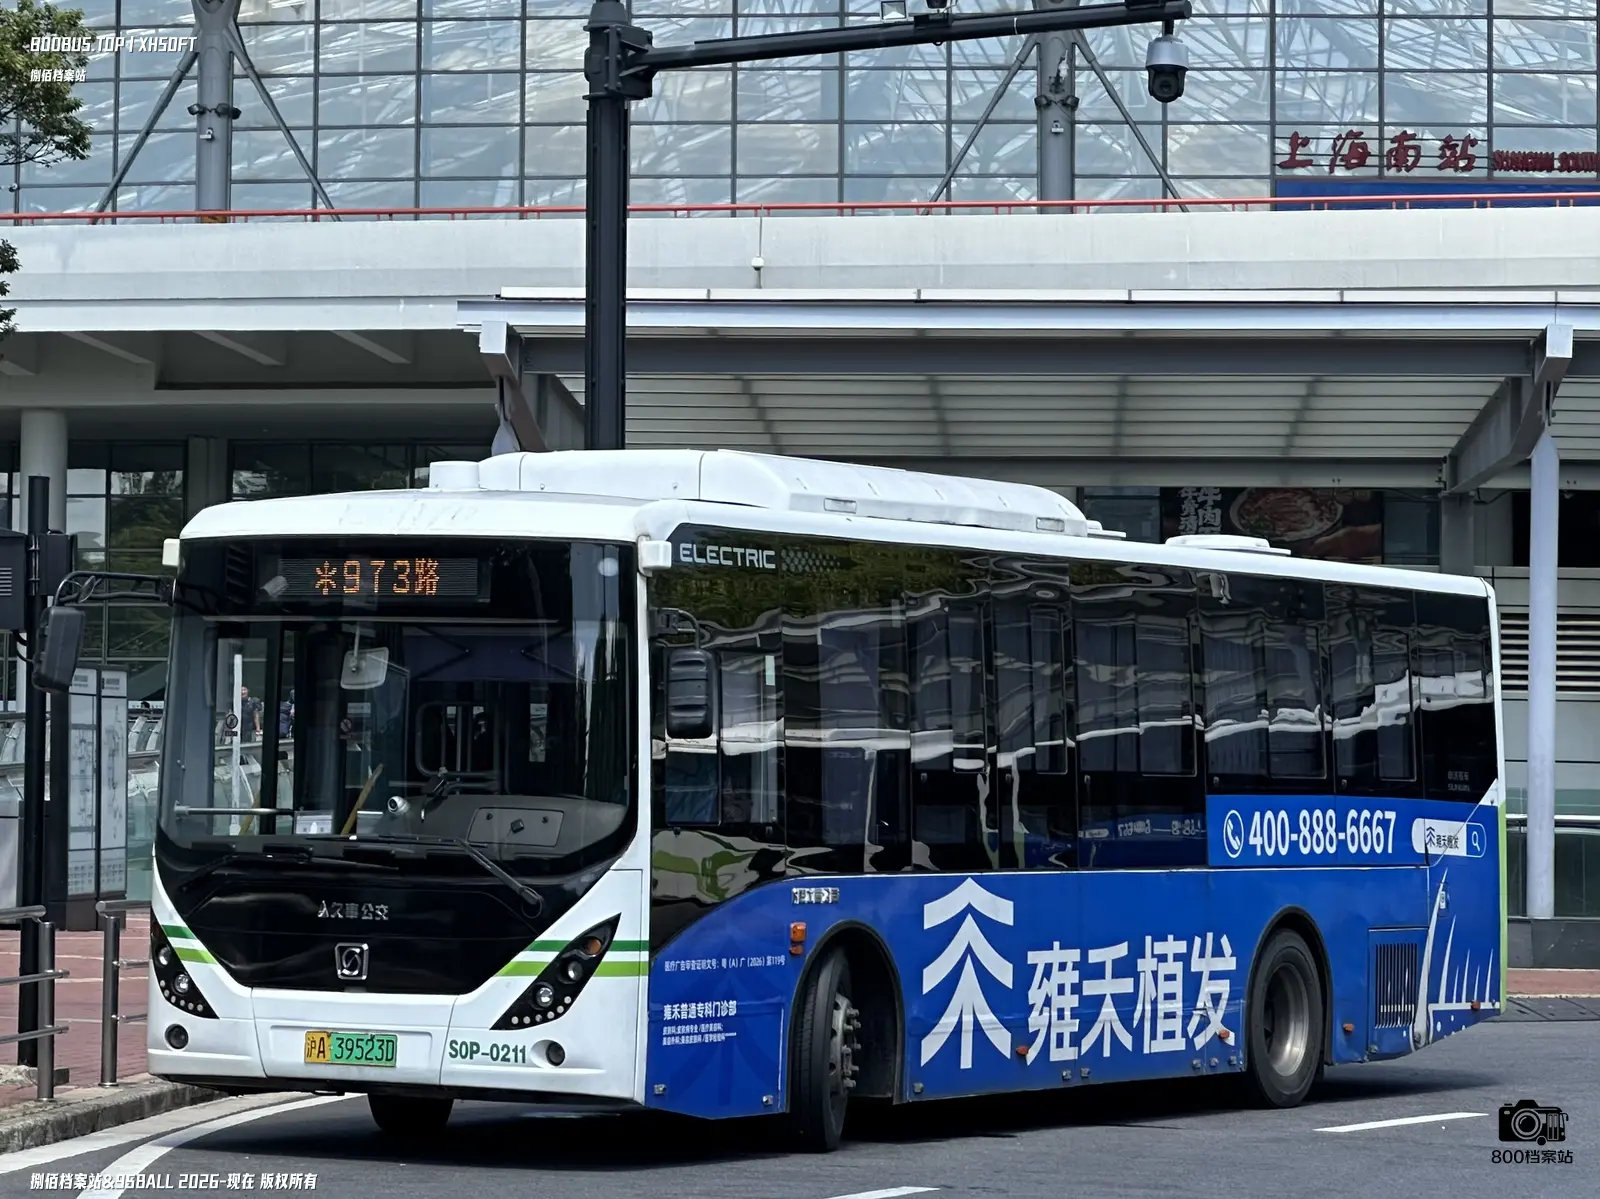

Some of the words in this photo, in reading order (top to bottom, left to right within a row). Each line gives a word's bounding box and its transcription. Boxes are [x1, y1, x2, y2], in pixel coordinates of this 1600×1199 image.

[1279, 130, 1478, 173] 上海南站
[679, 543, 776, 569] ELECTRIC
[1249, 808, 1396, 856] 400-888-6667
[663, 1000, 737, 1021] 雍禾普通专科门诊部
[1025, 932, 1237, 1066] 雍禾植发
[335, 1037, 395, 1062] 39523D
